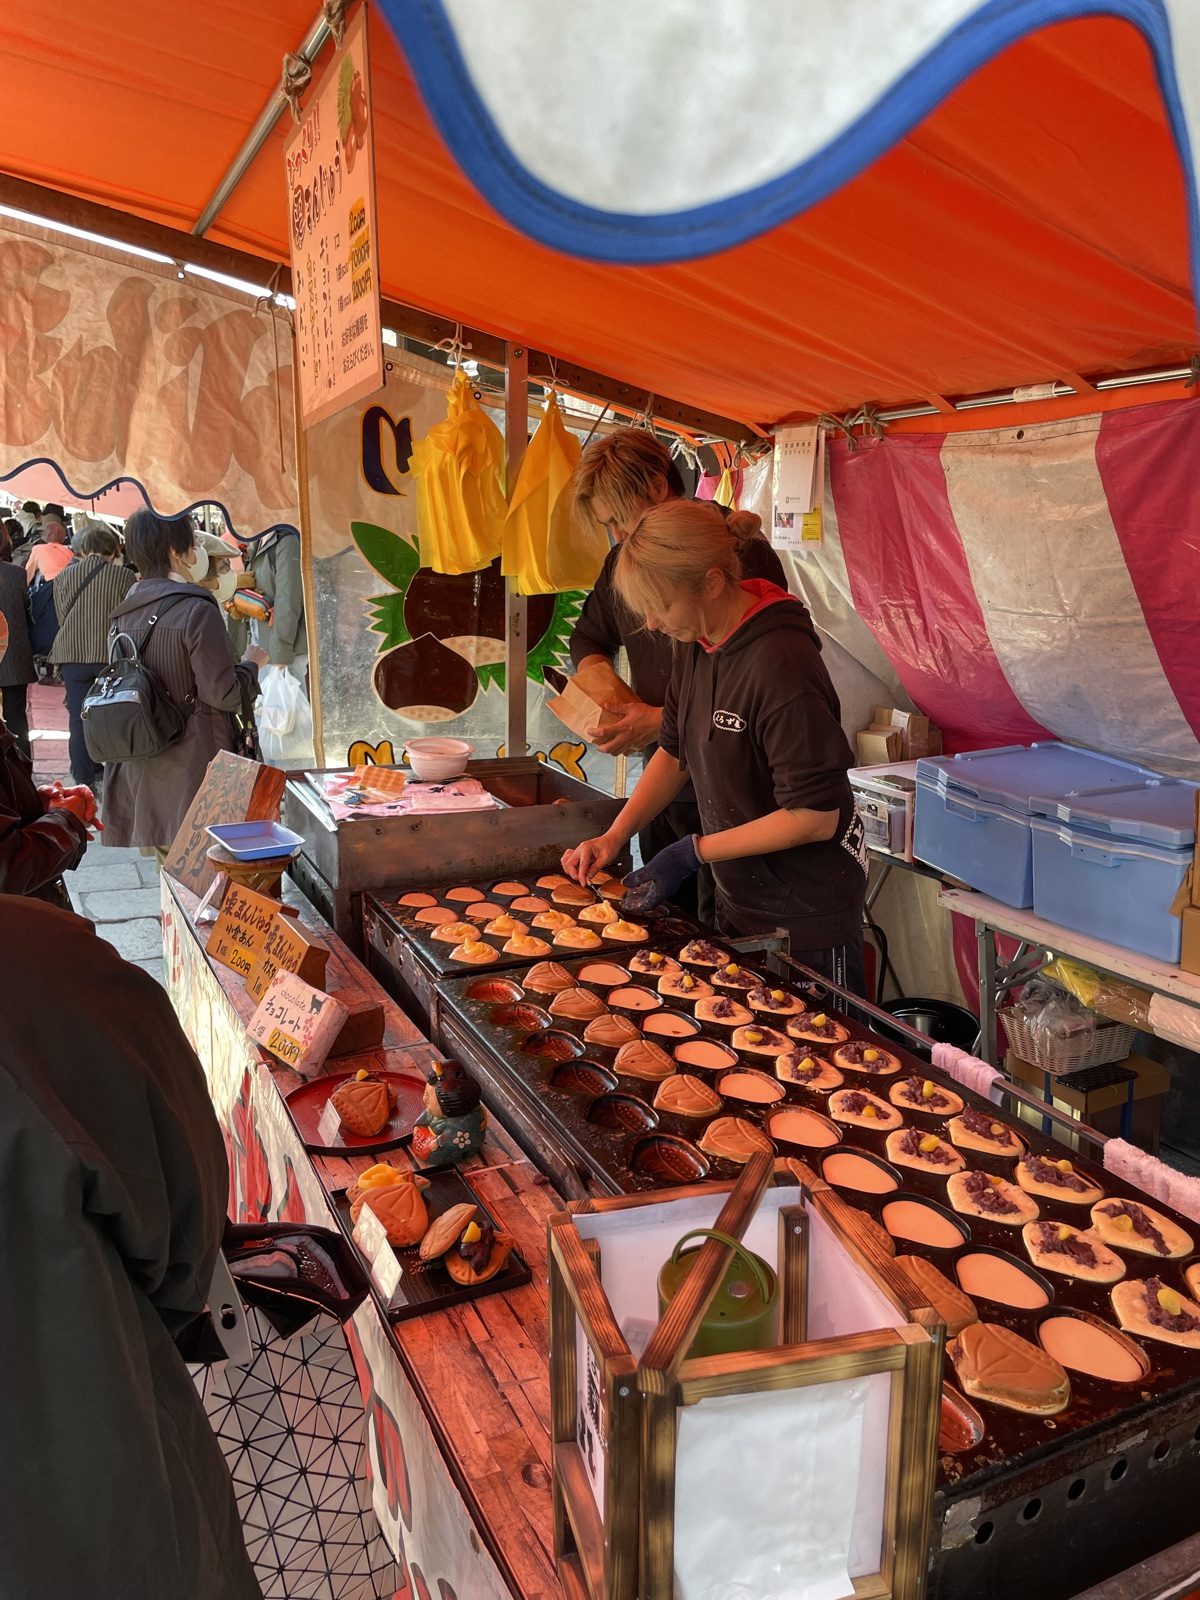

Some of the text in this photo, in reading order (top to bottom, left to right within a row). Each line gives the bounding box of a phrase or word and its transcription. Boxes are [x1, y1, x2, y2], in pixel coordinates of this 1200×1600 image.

[223, 891, 274, 934] 栗まんじゅう
[226, 924, 254, 948] 小倉あん
[230, 949, 252, 974] 200円
[266, 995, 301, 1033] チョコレート
[280, 988, 306, 1011] chocolate
[269, 1031, 300, 1064] 200円
